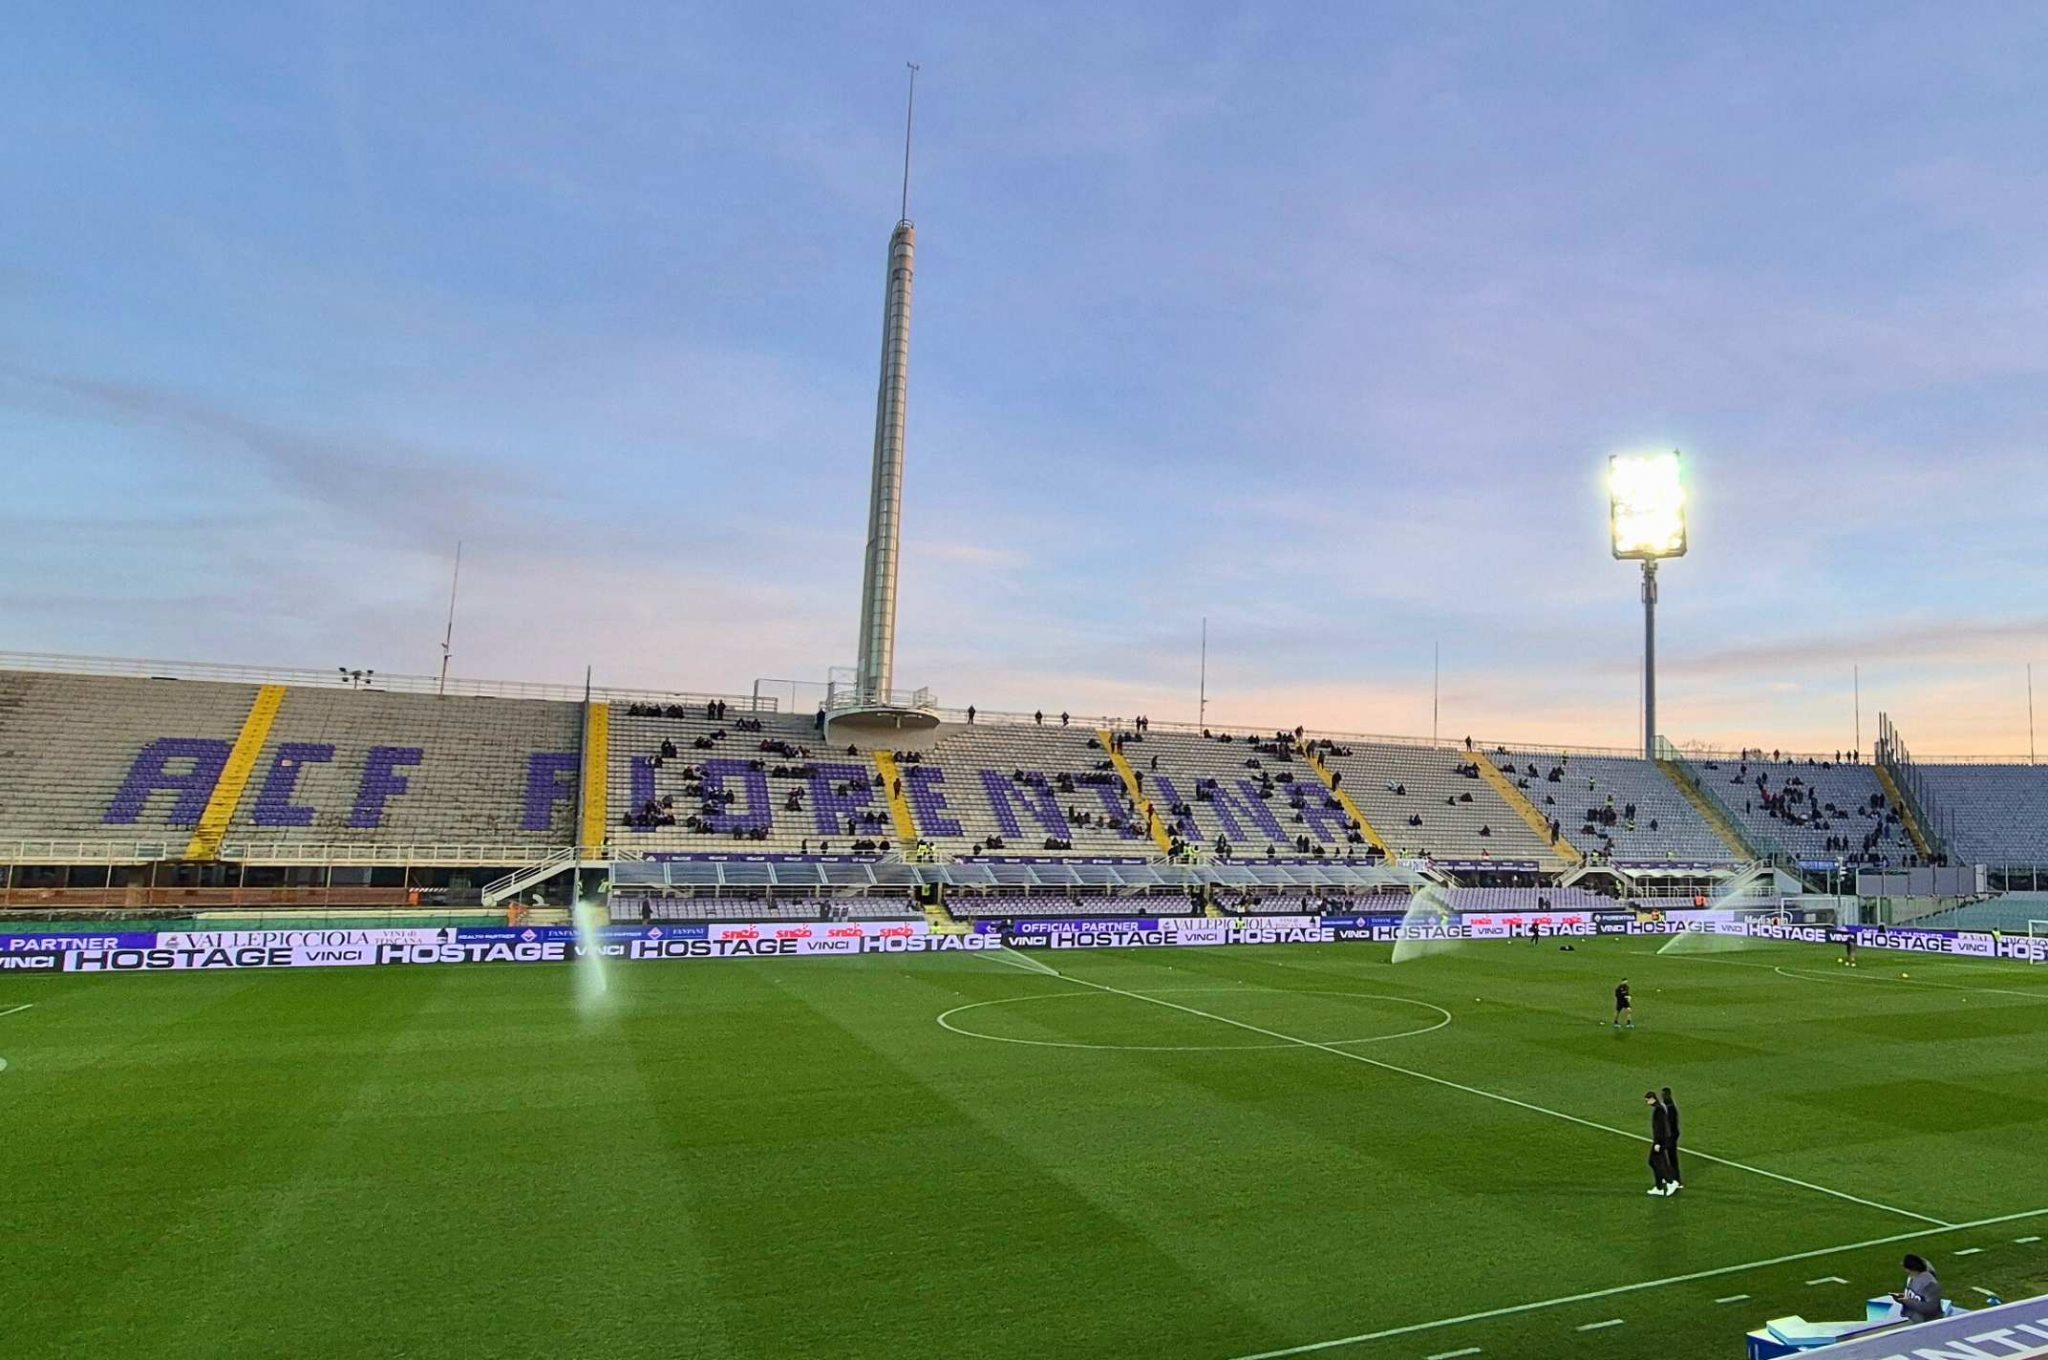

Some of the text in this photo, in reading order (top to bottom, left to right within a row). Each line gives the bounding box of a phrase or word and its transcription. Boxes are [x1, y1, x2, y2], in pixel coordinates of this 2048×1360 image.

[103, 737, 424, 829] ACF
[1022, 922, 1139, 933] OFFICIAL PARTNER
[1173, 918, 1272, 930] VALLEPICIOLA
[1378, 925, 1504, 940] HOSTAGE VINCI
[1751, 923, 1826, 942] HOSTAGE
[9, 937, 119, 950] PARTNER
[863, 934, 1047, 952] HOSTAGE VINCI
[1058, 931, 1217, 947] HOSTAGE VINCI
[1228, 928, 1370, 943] HOSTAGE VINCI
[1861, 933, 1987, 953] HOSTAGE VINCI
[381, 942, 565, 964] HOSTAGE
[639, 939, 849, 957] HOSTAGE VINCI
[1997, 942, 2048, 960] HOS
[75, 948, 362, 970] HOSTAGE VINCI
